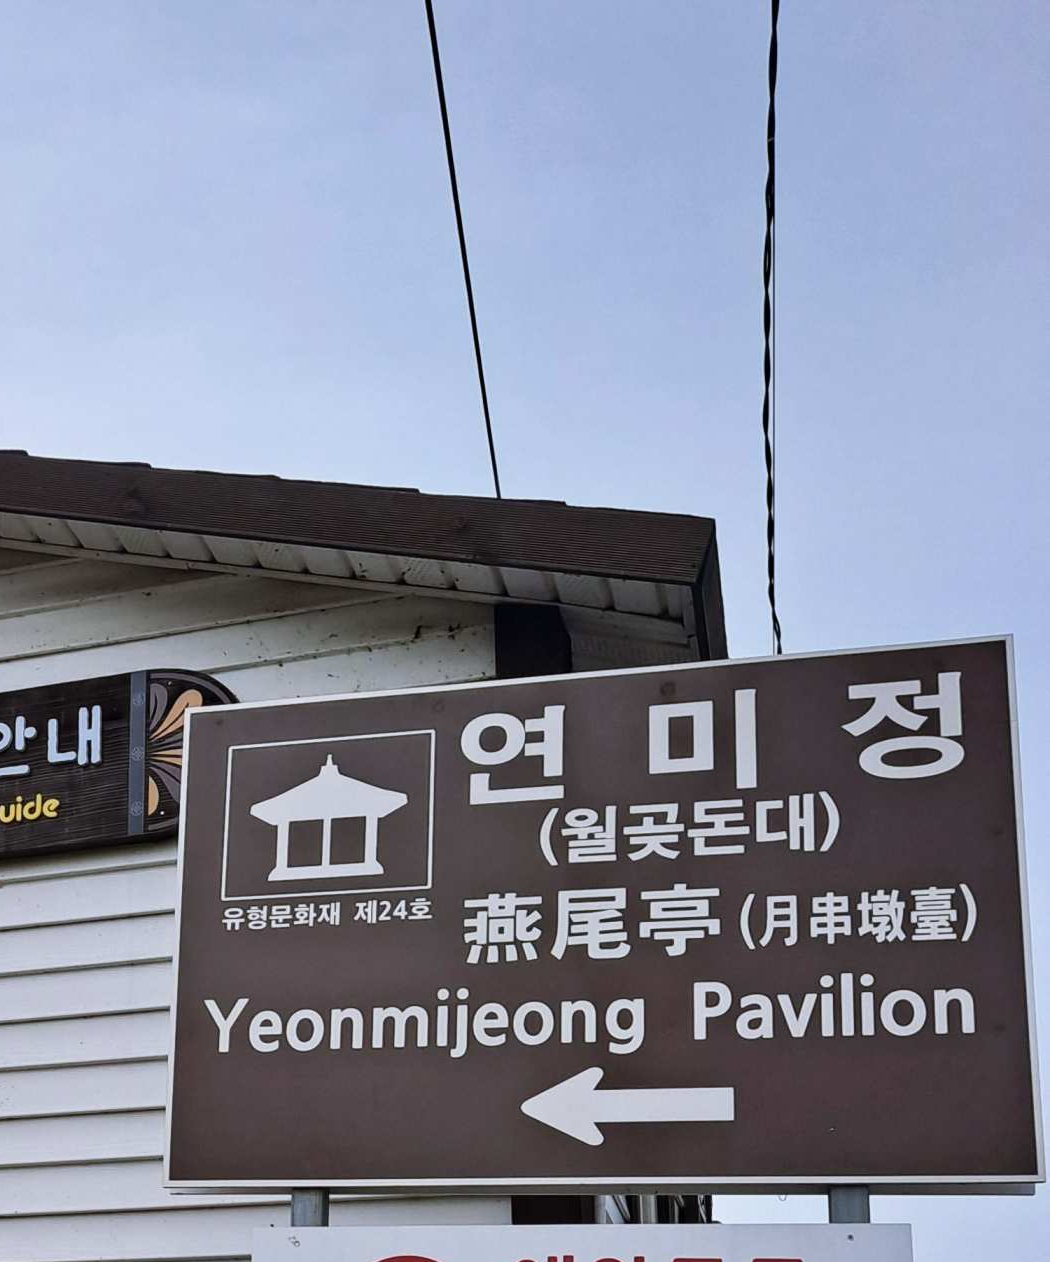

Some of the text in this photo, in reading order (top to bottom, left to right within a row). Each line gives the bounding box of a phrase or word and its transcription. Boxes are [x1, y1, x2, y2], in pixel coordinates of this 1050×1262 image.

[539, 791, 840, 866] (월곶돈대)
[221, 897, 433, 931] 유형문화재 제24호
[463, 883, 721, 964] 燕尾亭
[203, 972, 975, 1058] Yeonmijeong Pavilion
